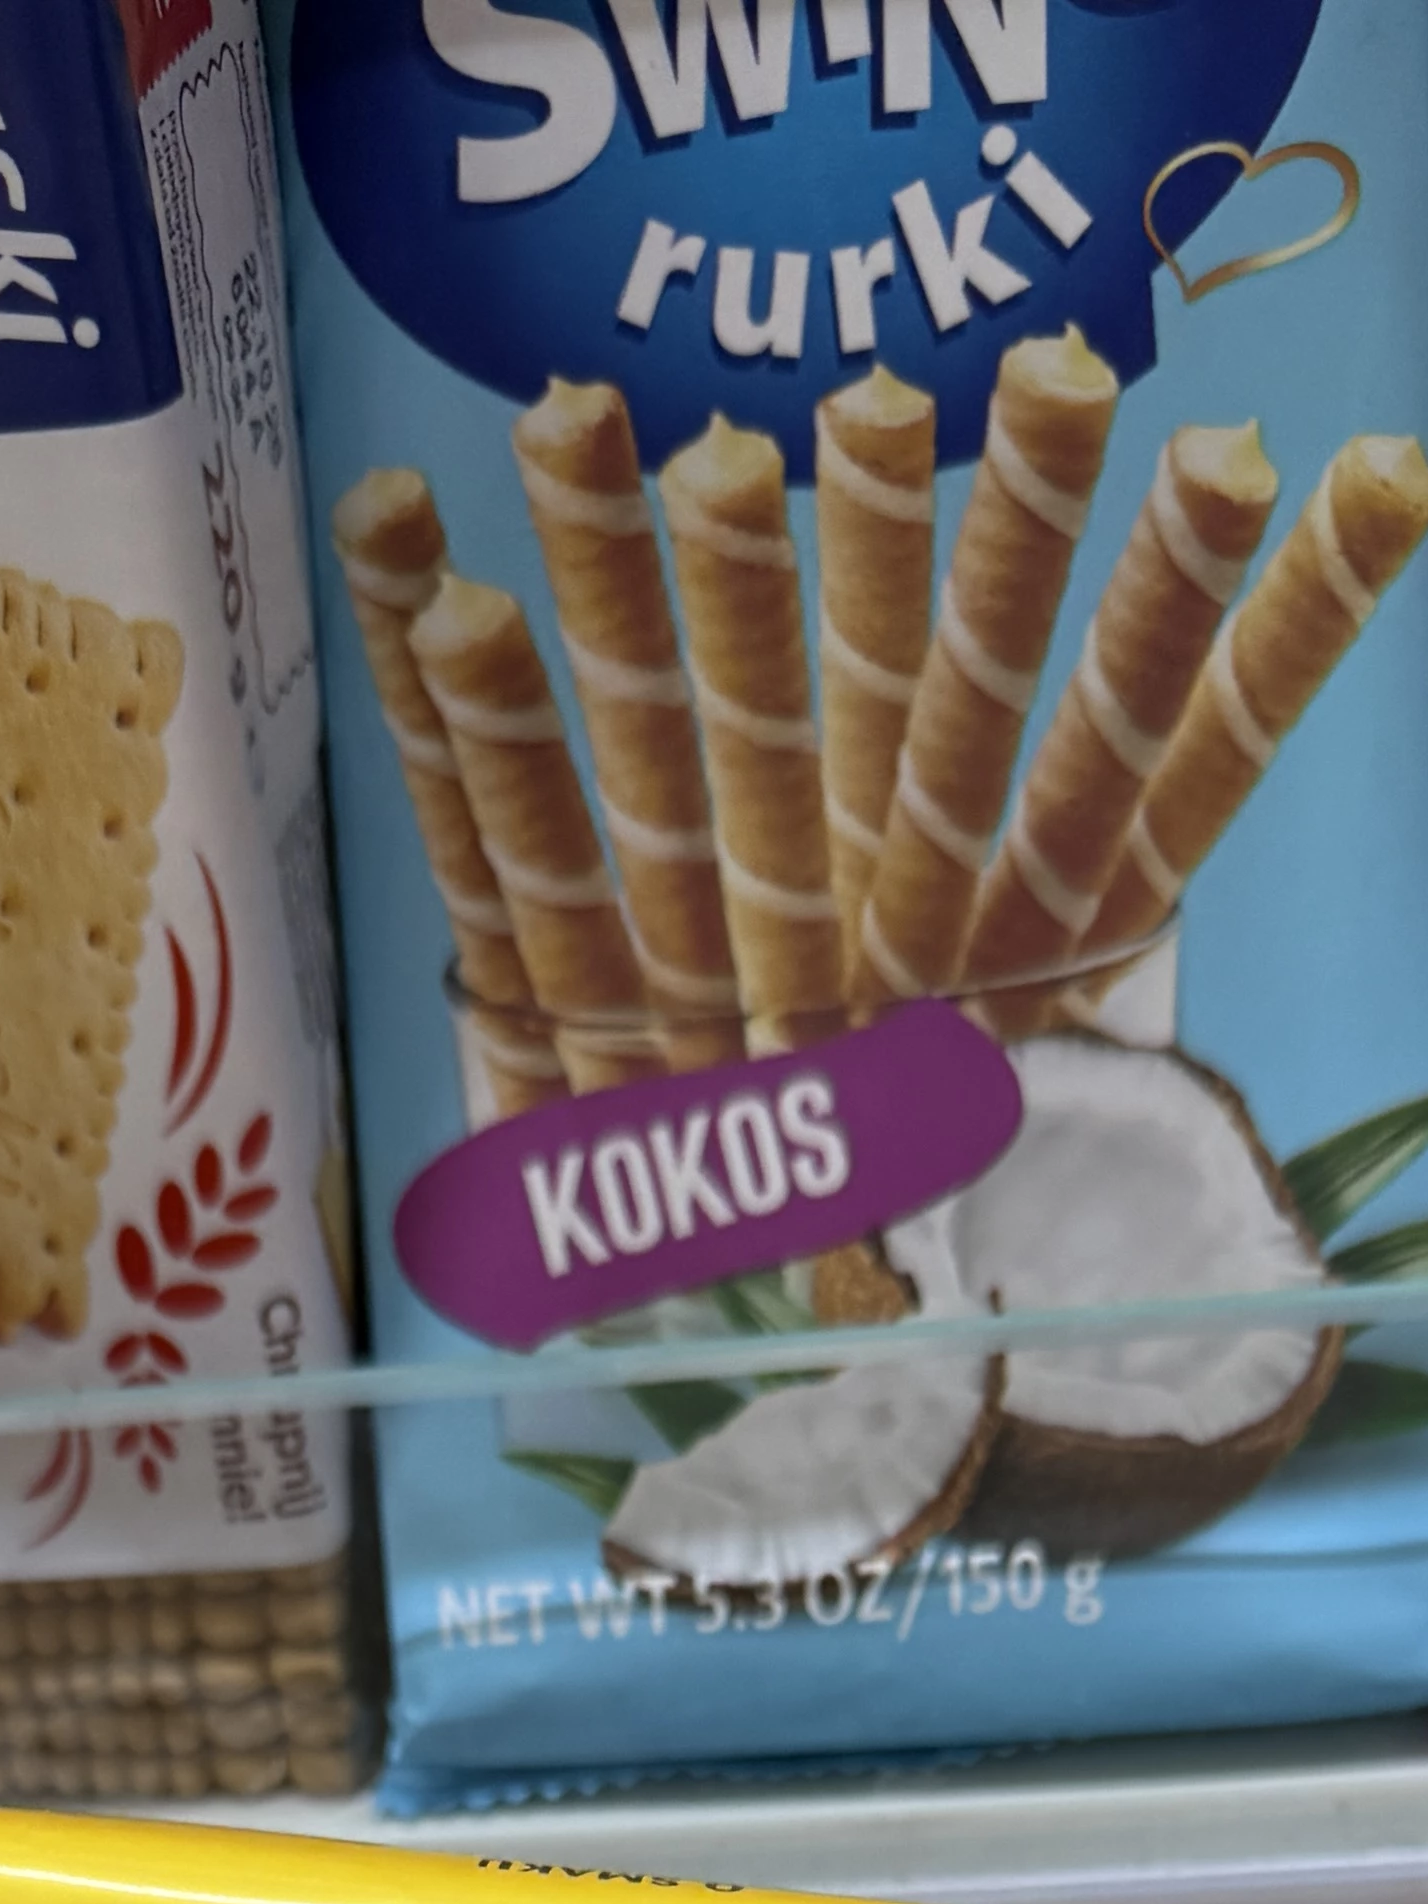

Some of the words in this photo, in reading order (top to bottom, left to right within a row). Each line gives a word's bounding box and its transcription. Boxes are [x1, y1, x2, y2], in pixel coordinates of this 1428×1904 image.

[615, 125, 1092, 358] rurki
[523, 1075, 851, 1281] KOKOS
[436, 1581, 547, 1648] NET
[568, 1573, 676, 1639] WT
[694, 1564, 788, 1633] 5.3
